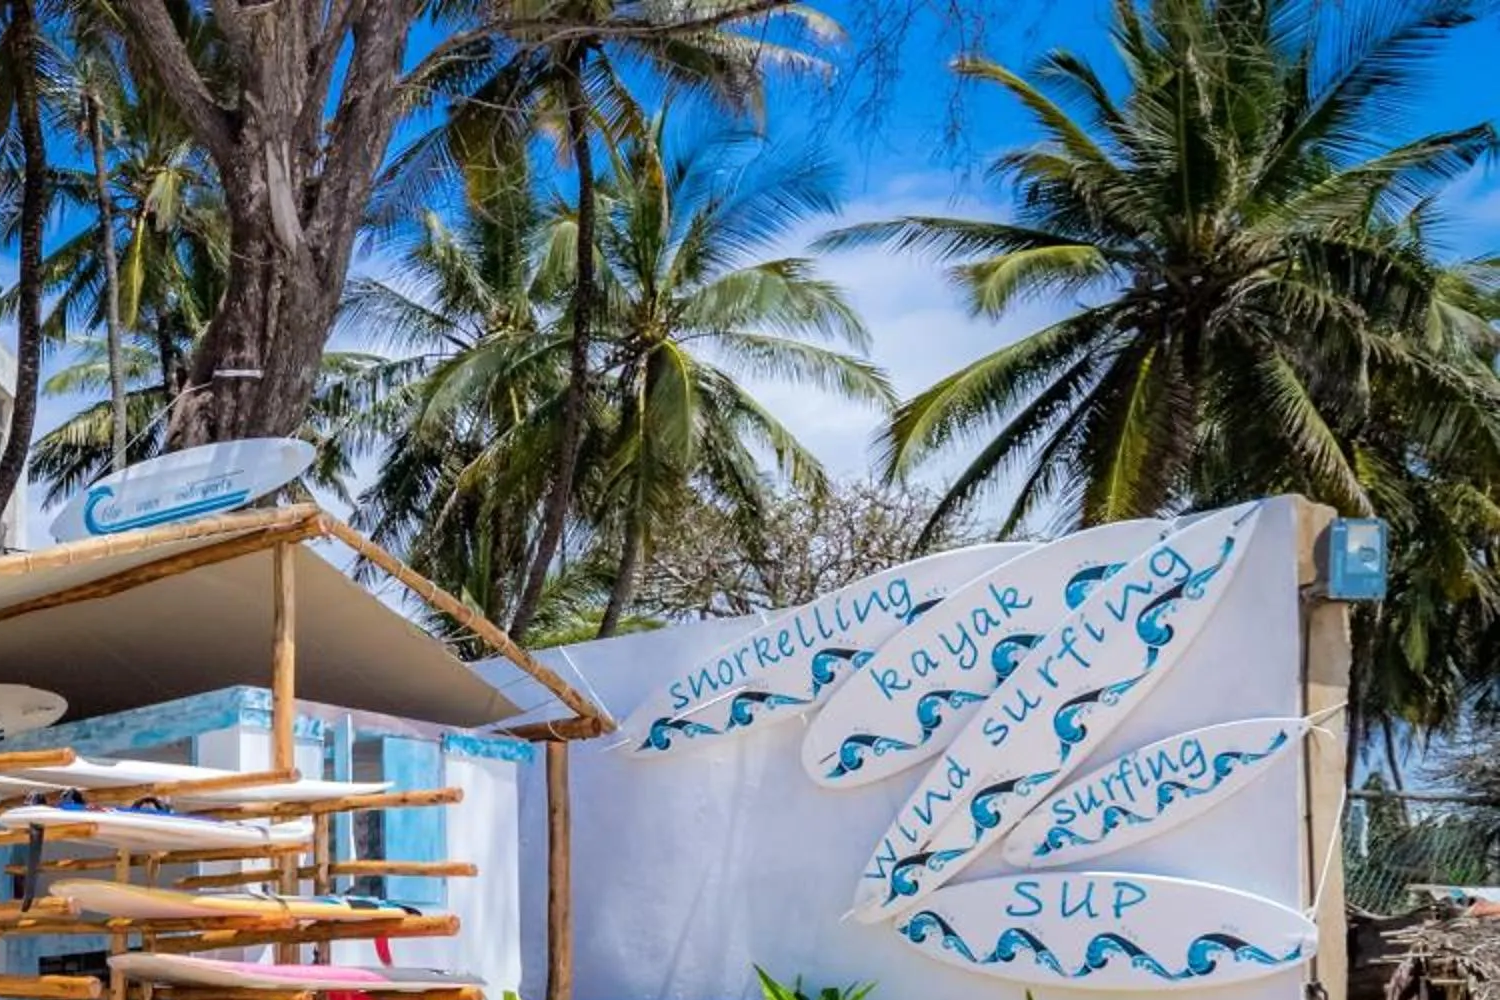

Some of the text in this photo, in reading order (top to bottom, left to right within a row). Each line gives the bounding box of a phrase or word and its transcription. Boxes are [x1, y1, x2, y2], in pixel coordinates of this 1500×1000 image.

[668, 577, 913, 710] snorkelling
[869, 583, 1033, 701] kayak
[863, 546, 1193, 881] wind surfing
[1051, 738, 1208, 826] surfing
[1005, 880, 1147, 920] SUP
